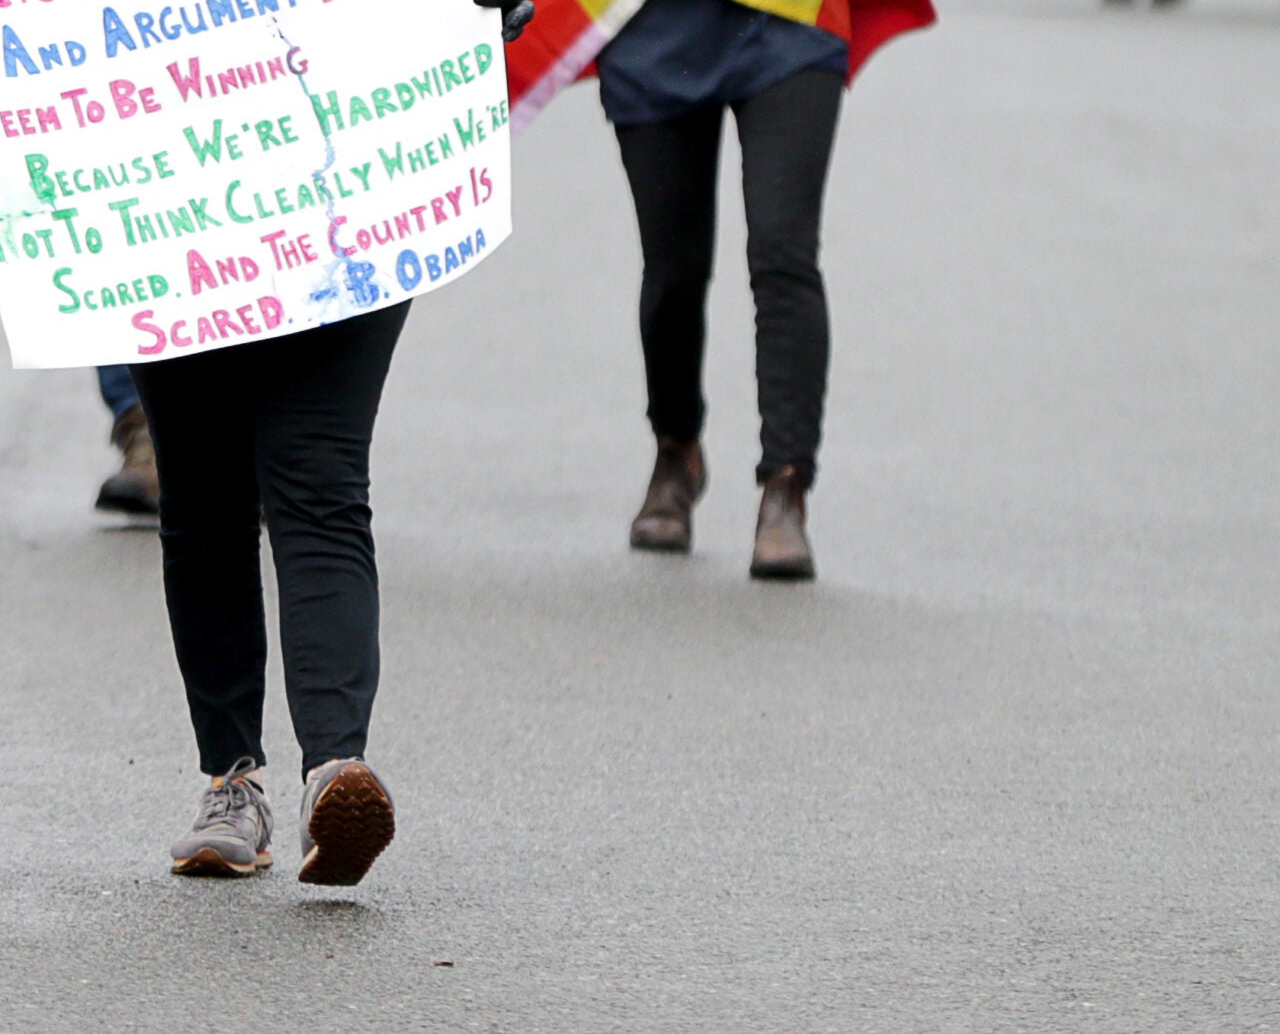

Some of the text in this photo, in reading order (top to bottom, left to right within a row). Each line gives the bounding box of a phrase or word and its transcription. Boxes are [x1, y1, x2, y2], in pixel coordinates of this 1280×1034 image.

[2, 24, 87, 77] AND
[60, 88, 105, 128] TO
[109, 79, 162, 119] BE
[166, 46, 309, 102] WINNING
[25, 151, 176, 203] BECAUSE
[310, 43, 493, 137] HARDWIRED
[52, 207, 103, 254] TO
[108, 197, 224, 246] THINK
[225, 162, 372, 224] CLEARLY
[377, 133, 455, 181] WHEN
[52, 167, 493, 314] SCARED. AND THE COUNTRY IS
[396, 228, 487, 292] OBAMA
